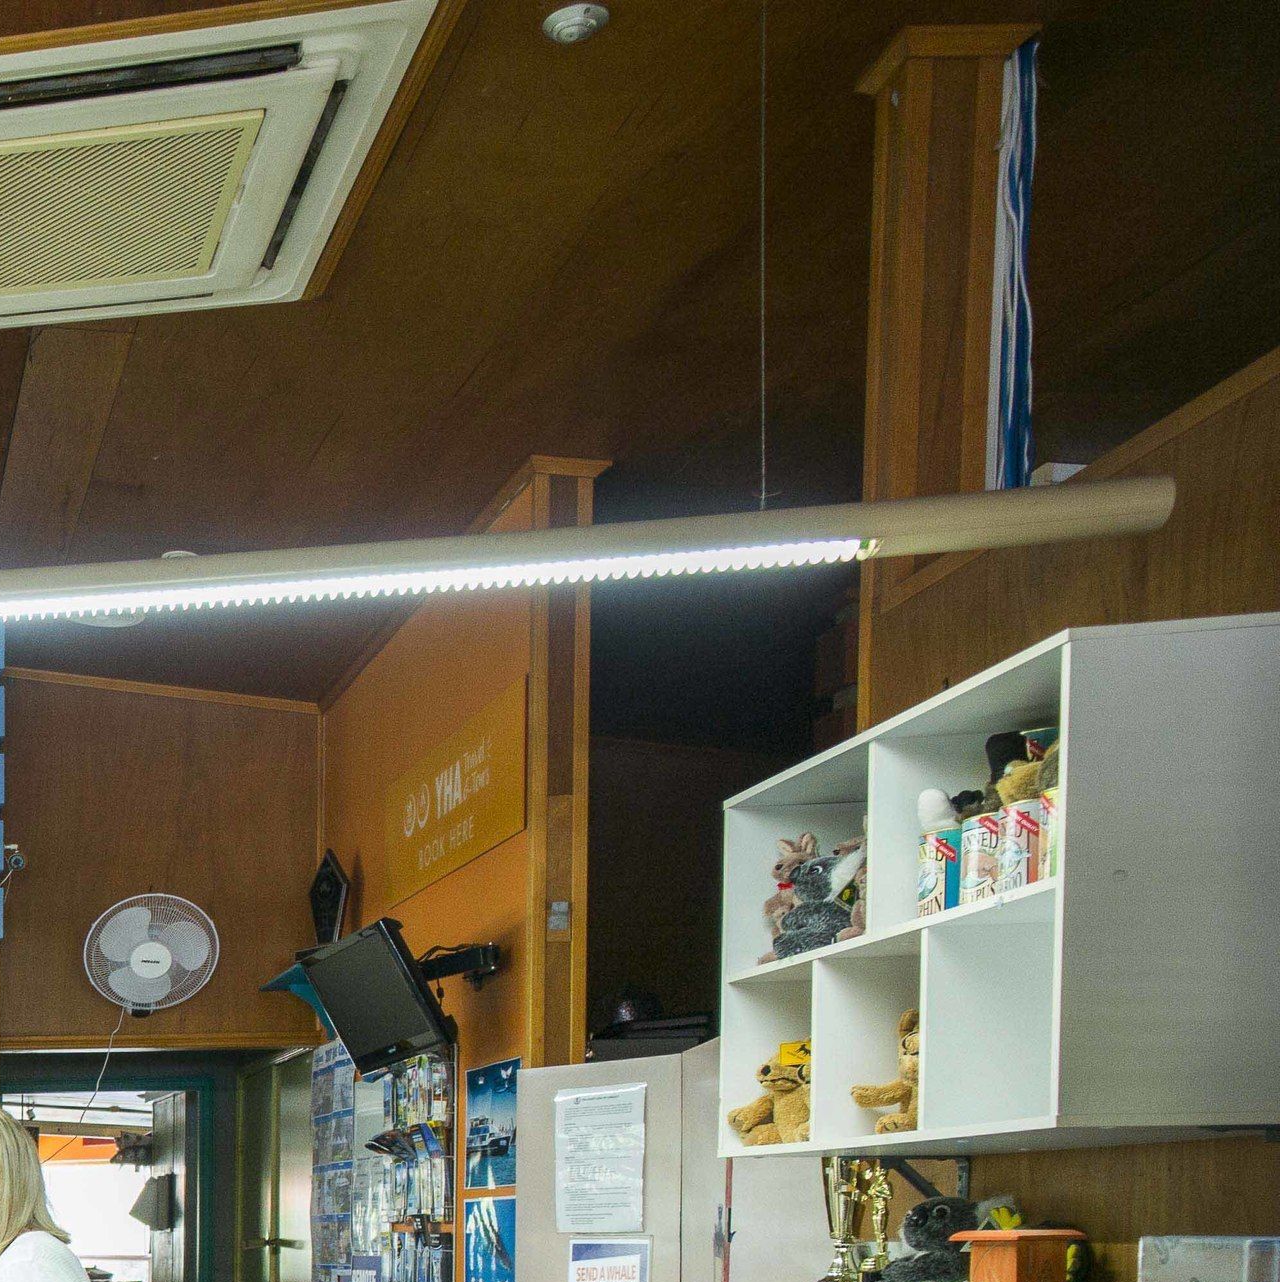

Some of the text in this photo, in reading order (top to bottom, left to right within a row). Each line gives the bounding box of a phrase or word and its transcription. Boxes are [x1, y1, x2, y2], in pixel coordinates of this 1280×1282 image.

[435, 760, 461, 820] YHA
[576, 1265, 637, 1282] SEND A WHALE
